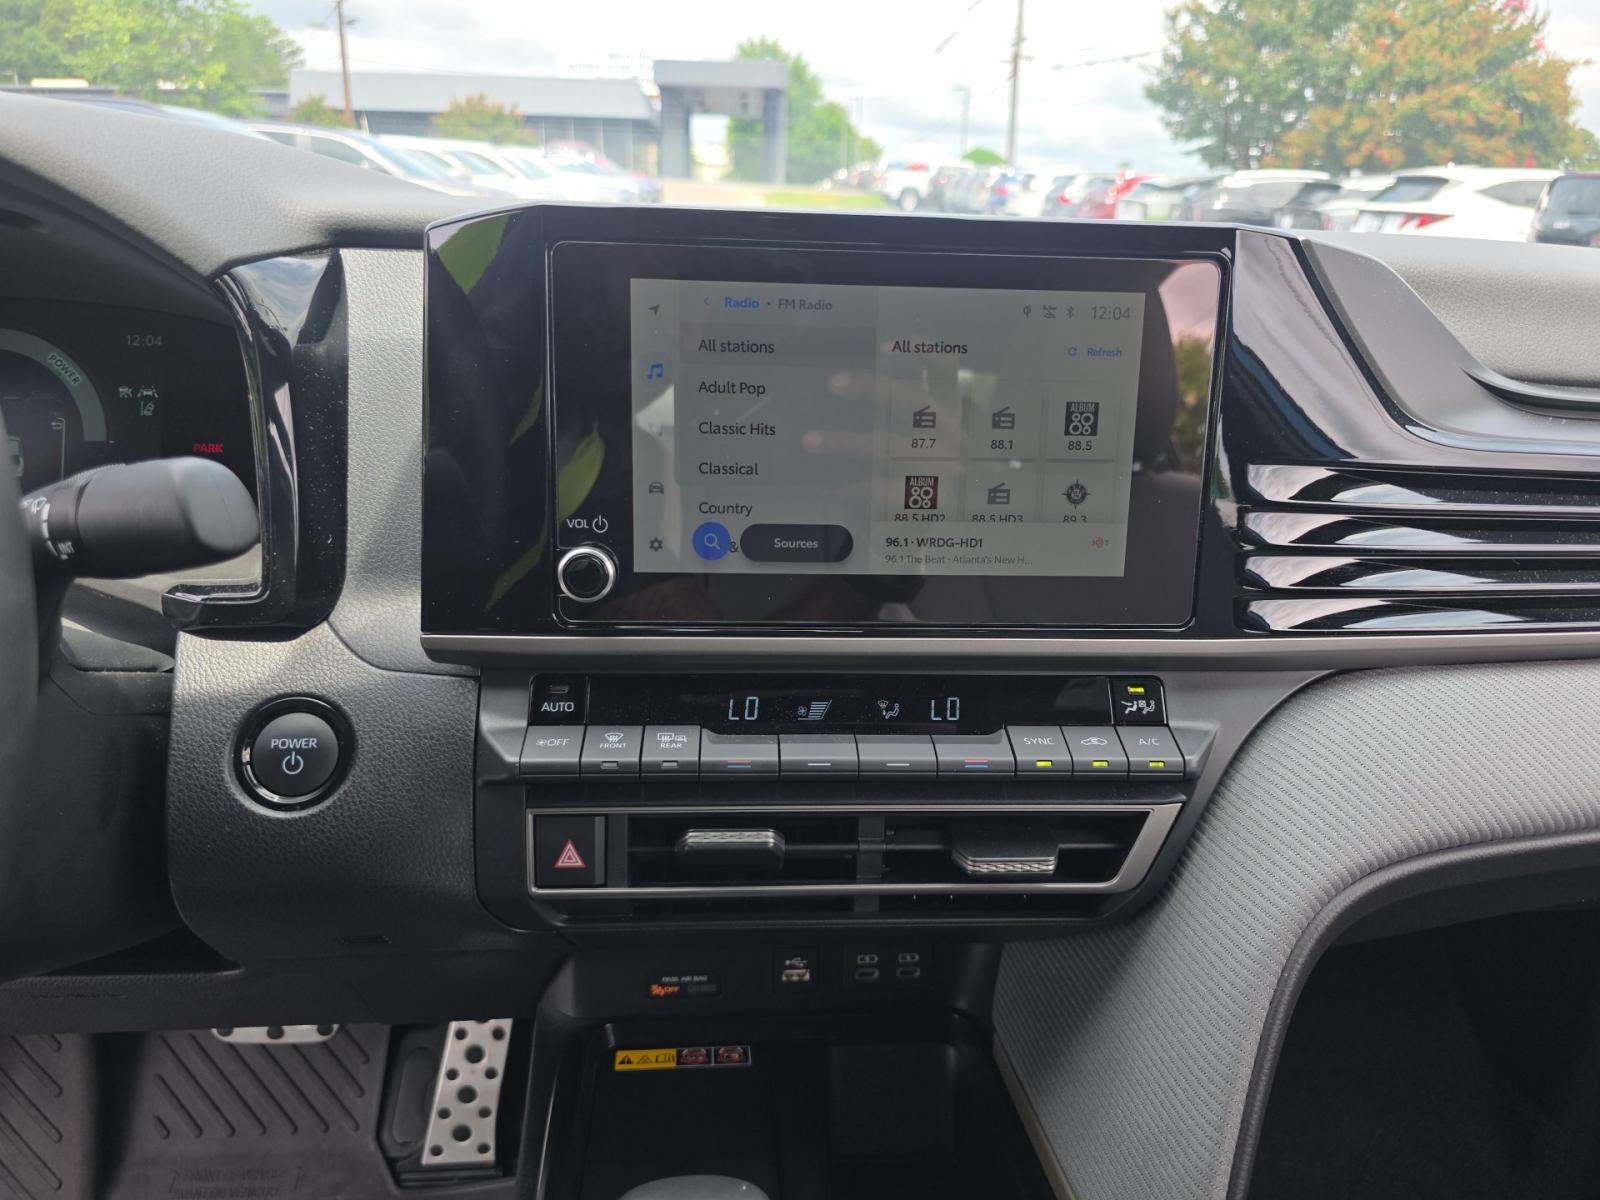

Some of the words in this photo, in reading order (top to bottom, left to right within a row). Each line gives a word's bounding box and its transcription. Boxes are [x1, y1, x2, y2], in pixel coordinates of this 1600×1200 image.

[724, 296, 760, 309] Radio
[777, 298, 796, 310] FM
[799, 299, 833, 311] Radio
[1091, 305, 1130, 320] 12:04
[126, 334, 163, 347] 12:04
[698, 339, 716, 352] All
[720, 340, 775, 353] stations
[892, 340, 911, 354] All
[914, 341, 968, 354] stations
[1086, 346, 1122, 357] Refresh
[49, 354, 80, 385] POWER
[698, 380, 736, 394] Adult
[739, 381, 766, 397] Pop
[698, 422, 746, 436] Classic
[750, 422, 776, 436] Hits
[192, 443, 224, 453] PARK
[911, 438, 936, 449] 87.7
[990, 439, 1014, 450] 88.1
[1067, 440, 1092, 451] 88.5
[698, 462, 759, 476] Classical
[698, 502, 753, 517] Country
[894, 513, 920, 522] 885
[972, 514, 996, 523] 885
[1062, 514, 1088, 523] 893
[566, 518, 590, 529] VOL
[774, 537, 819, 549] Sources
[917, 537, 983, 548] WRDG-HD1
[906, 554, 922, 564] The
[925, 554, 944, 564] Beat
[994, 555, 1015, 565] New
[540, 701, 575, 712] AUTO
[727, 696, 759, 721] LO
[931, 696, 960, 721] LO
[271, 738, 318, 749] POWER
[546, 738, 570, 746] OFF
[1023, 736, 1055, 745] SYNC
[1138, 738, 1160, 746] A/C
